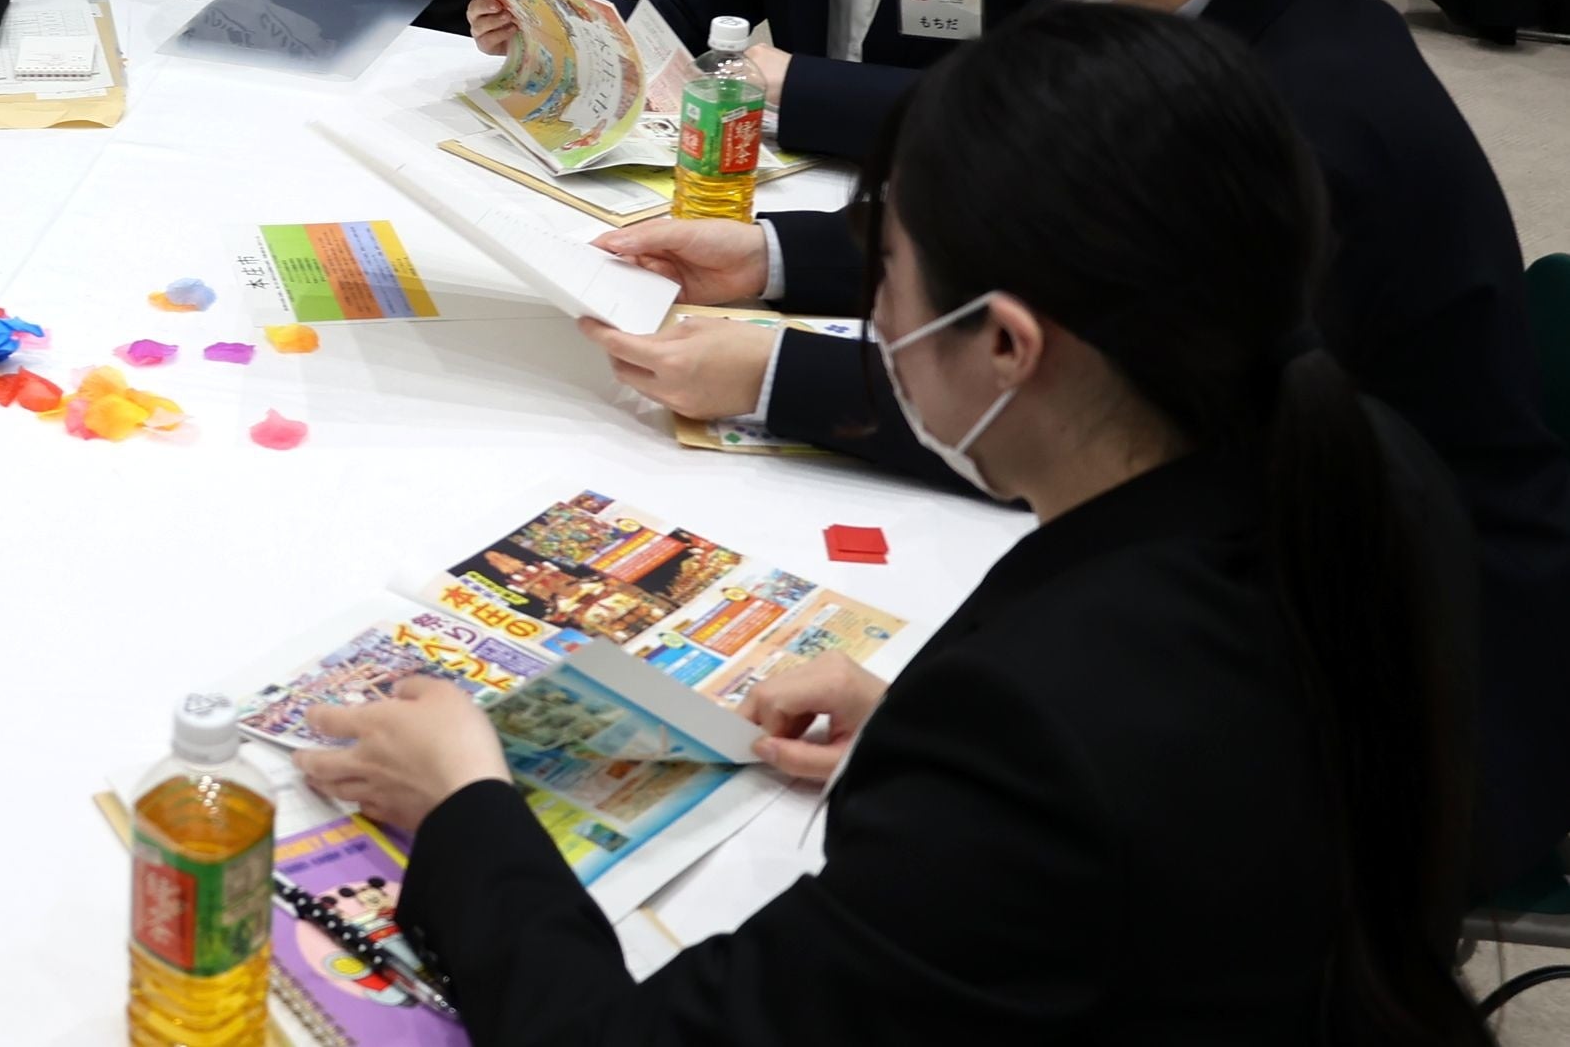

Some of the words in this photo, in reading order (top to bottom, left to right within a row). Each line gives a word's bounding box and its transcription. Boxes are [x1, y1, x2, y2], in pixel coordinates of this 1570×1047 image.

[920, 16, 959, 31] もちだ
[238, 255, 271, 290] 本庄市
[412, 613, 477, 645] 祭り
[441, 586, 539, 638] 本庄の
[394, 625, 512, 692] イベント
